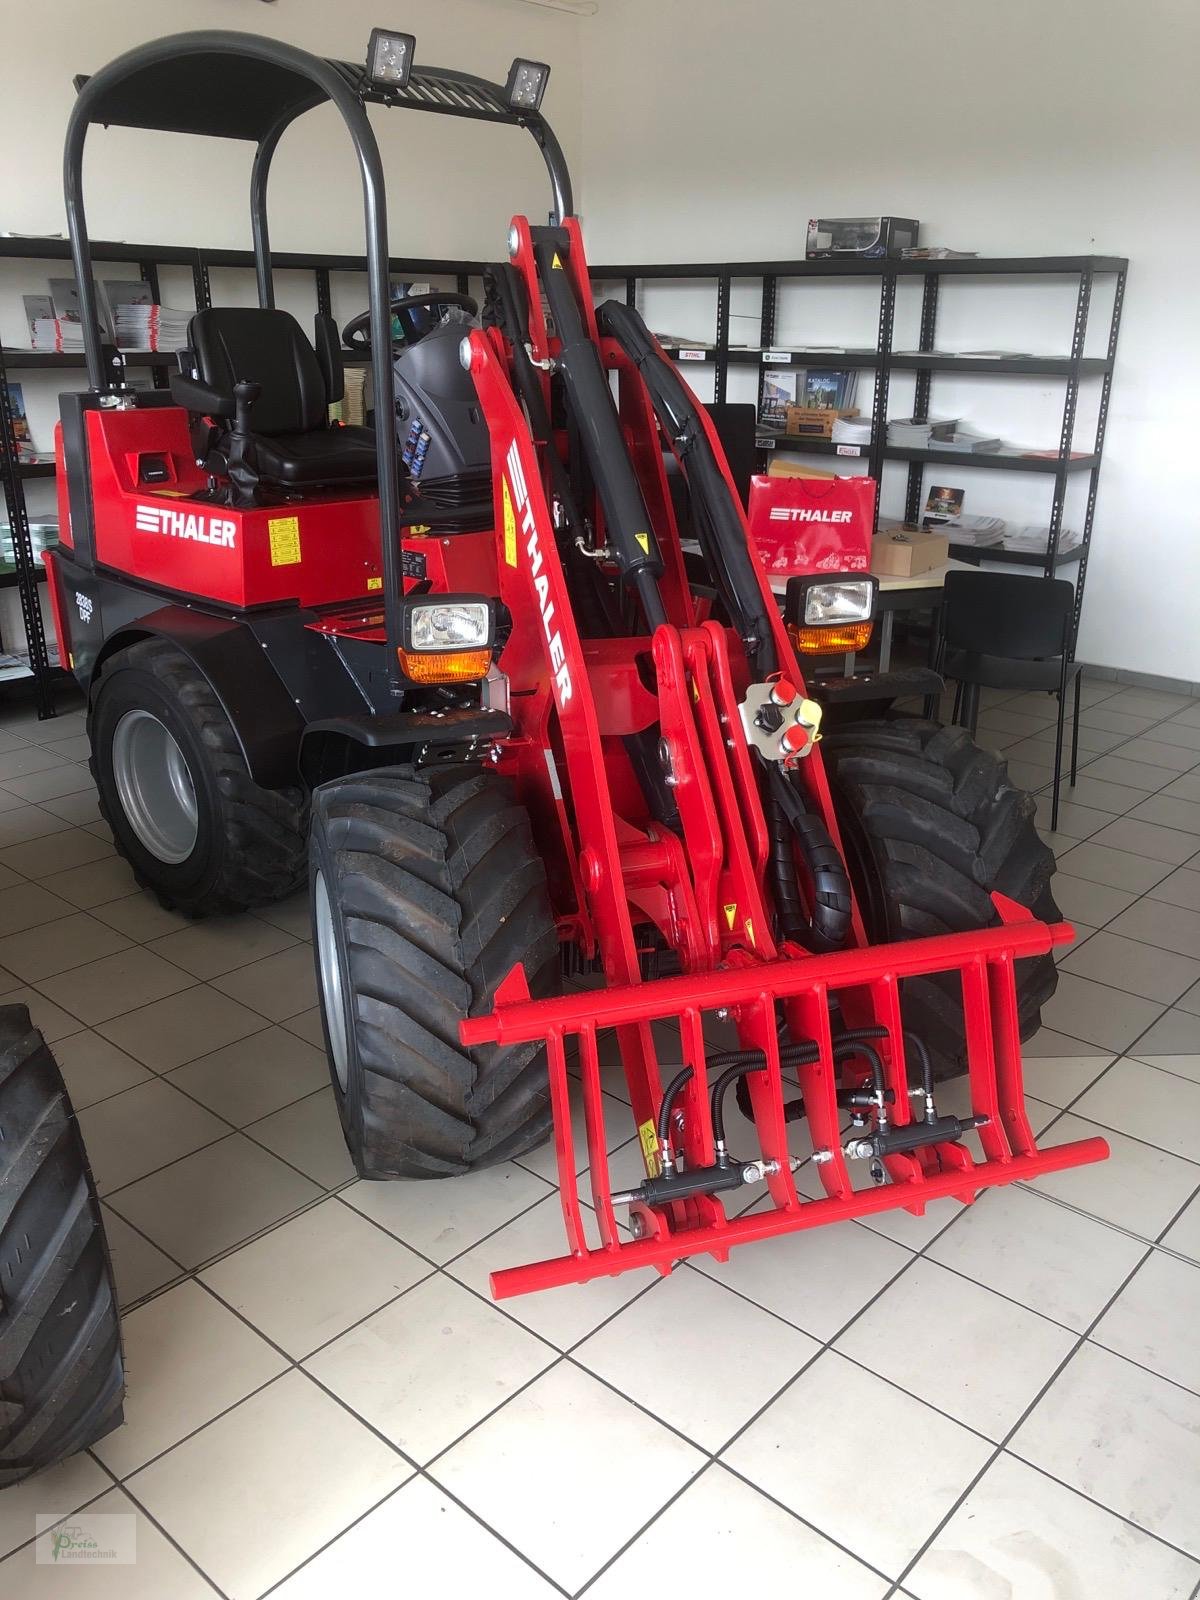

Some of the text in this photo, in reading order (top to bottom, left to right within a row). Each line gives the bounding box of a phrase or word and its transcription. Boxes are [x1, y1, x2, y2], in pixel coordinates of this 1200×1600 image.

[159, 509, 236, 548] THALER
[790, 508, 852, 523] THALER
[521, 497, 572, 709] THALER
